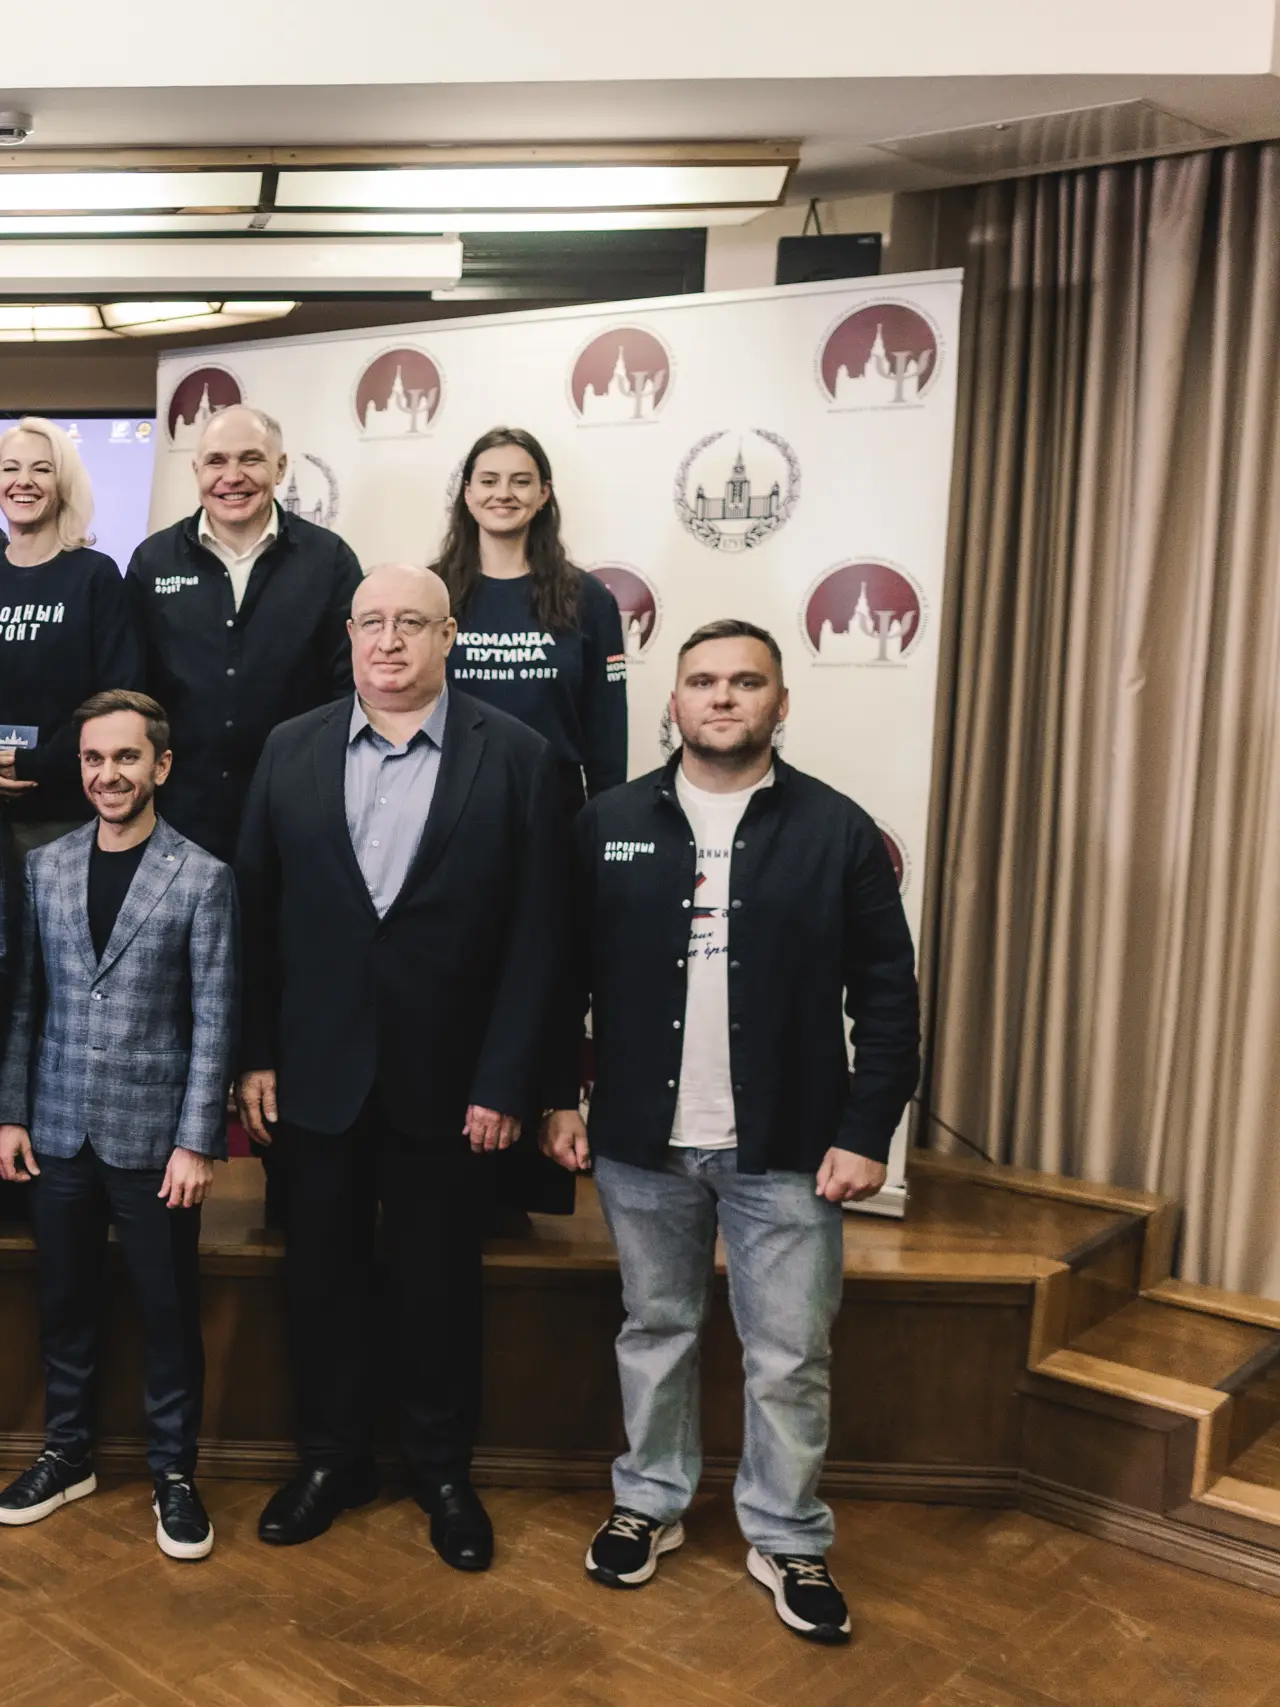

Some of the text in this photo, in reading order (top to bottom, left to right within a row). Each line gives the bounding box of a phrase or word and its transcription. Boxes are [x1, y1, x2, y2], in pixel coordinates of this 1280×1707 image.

[456, 632, 556, 647] КОМАНДА
[466, 647, 547, 662] ПУТИНА
[454, 667, 559, 680] НАРОДНЫЙ ФРОНТ
[605, 841, 656, 854] НАРОДНЫЙ
[603, 850, 635, 862] ФРОНТ
